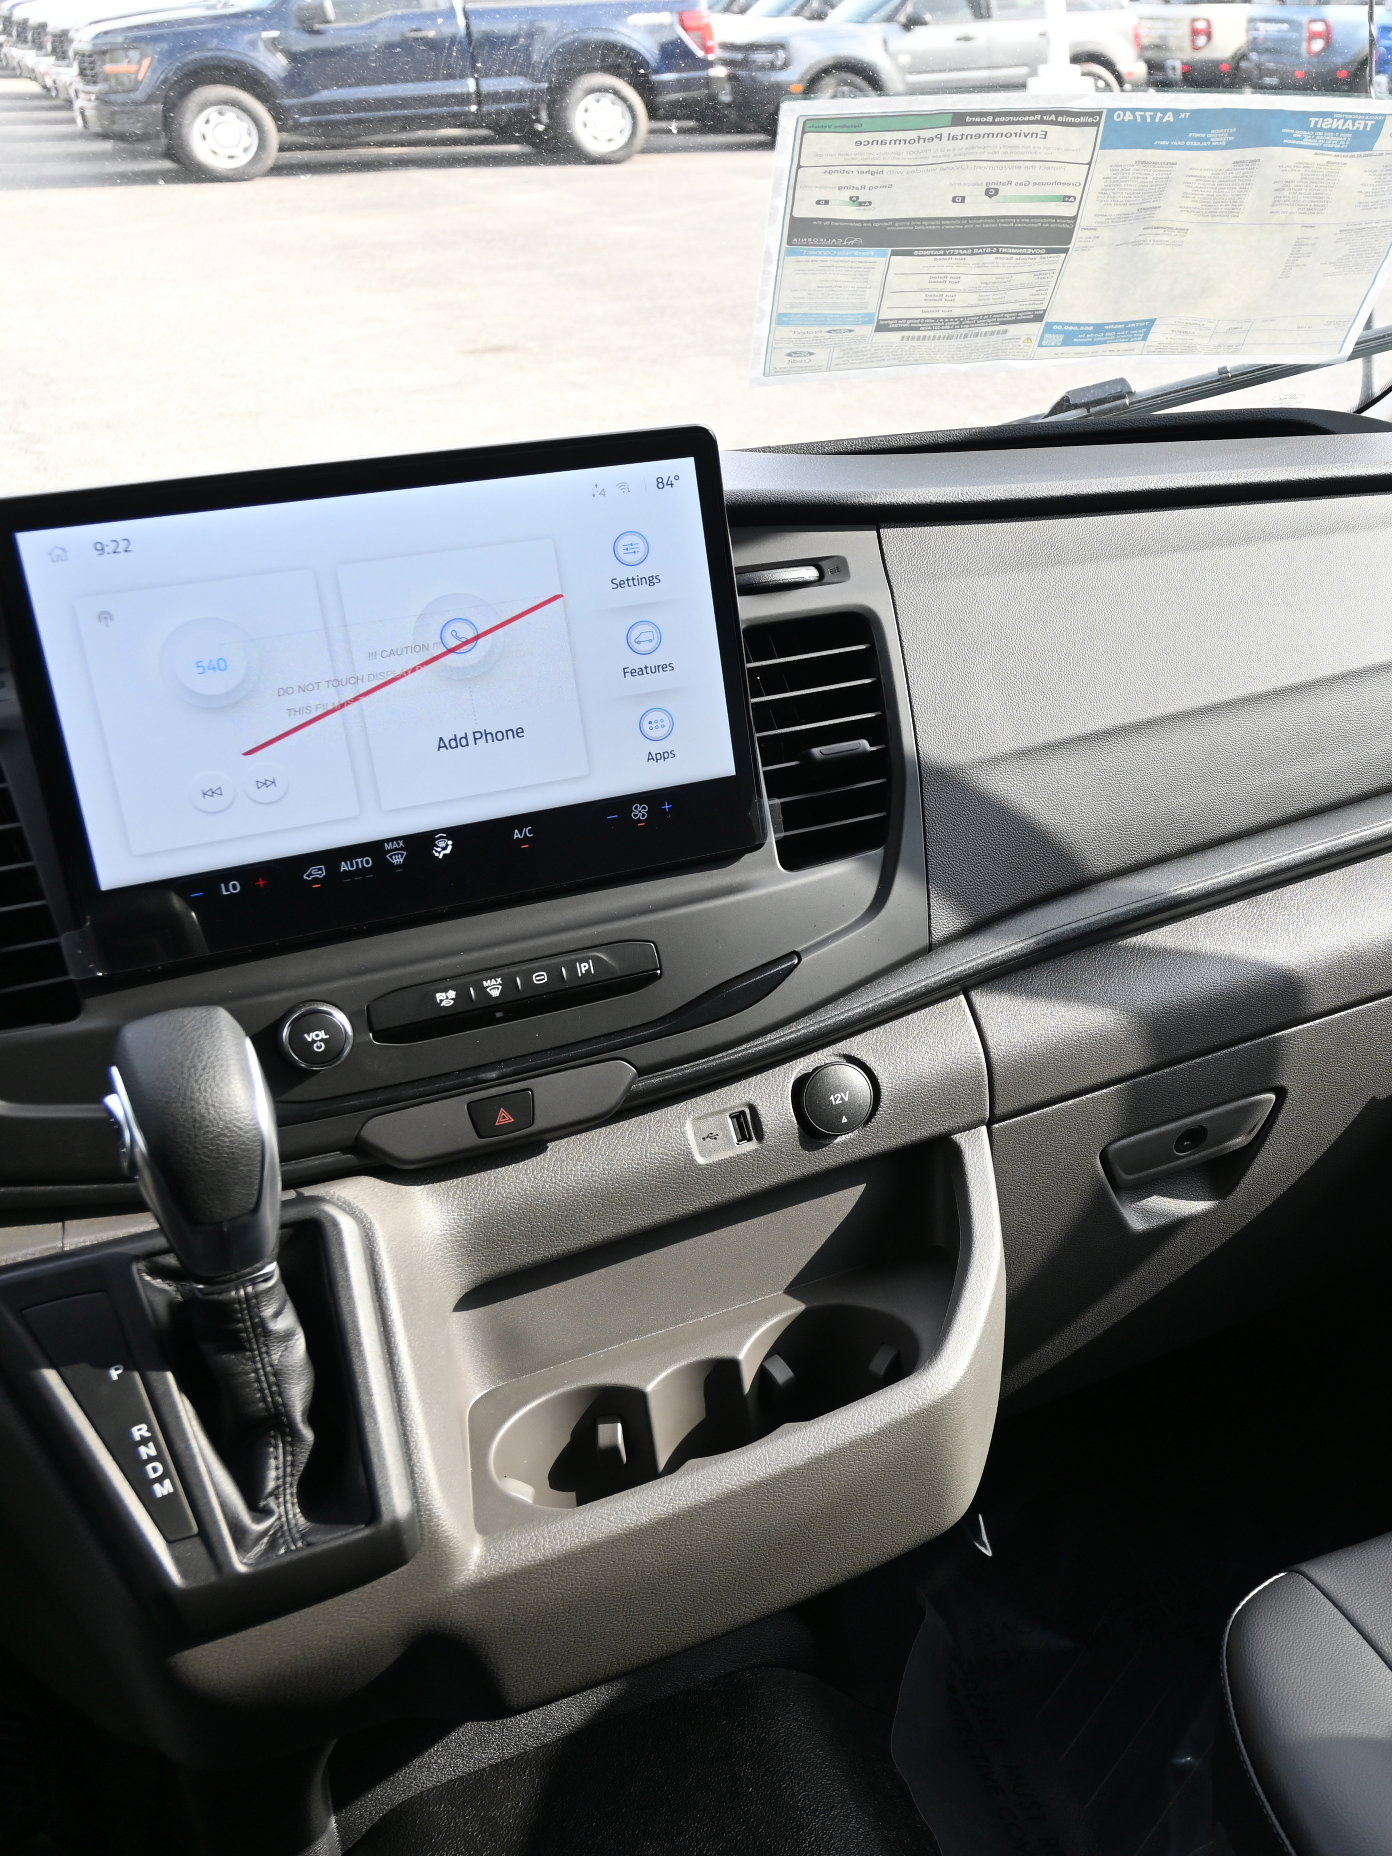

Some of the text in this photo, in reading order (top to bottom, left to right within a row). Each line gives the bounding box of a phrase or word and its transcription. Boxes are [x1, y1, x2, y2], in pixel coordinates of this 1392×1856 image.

[92, 538, 133, 556] 9:22
[610, 574, 662, 590] Settings
[380, 642, 430, 659] CAUTION
[195, 656, 228, 676] 540
[622, 662, 675, 679] Features
[277, 686, 295, 698] DO
[297, 681, 321, 696] NOT
[325, 674, 364, 690] TOUCH
[286, 705, 312, 718] THIS
[437, 726, 525, 752] Add Phone
[646, 750, 676, 762] Apps
[514, 826, 534, 840] A/C
[384, 840, 405, 850] MAX
[340, 856, 373, 874] AUTO
[220, 880, 241, 896] LO
[482, 976, 502, 988] MAX
[304, 1030, 330, 1042] VOL
[830, 1090, 850, 1106] 12V
[109, 1364, 124, 1381] P
[131, 1423, 152, 1442] R
[138, 1442, 158, 1460] N
[145, 1461, 164, 1480] D
[152, 1478, 174, 1498] M
